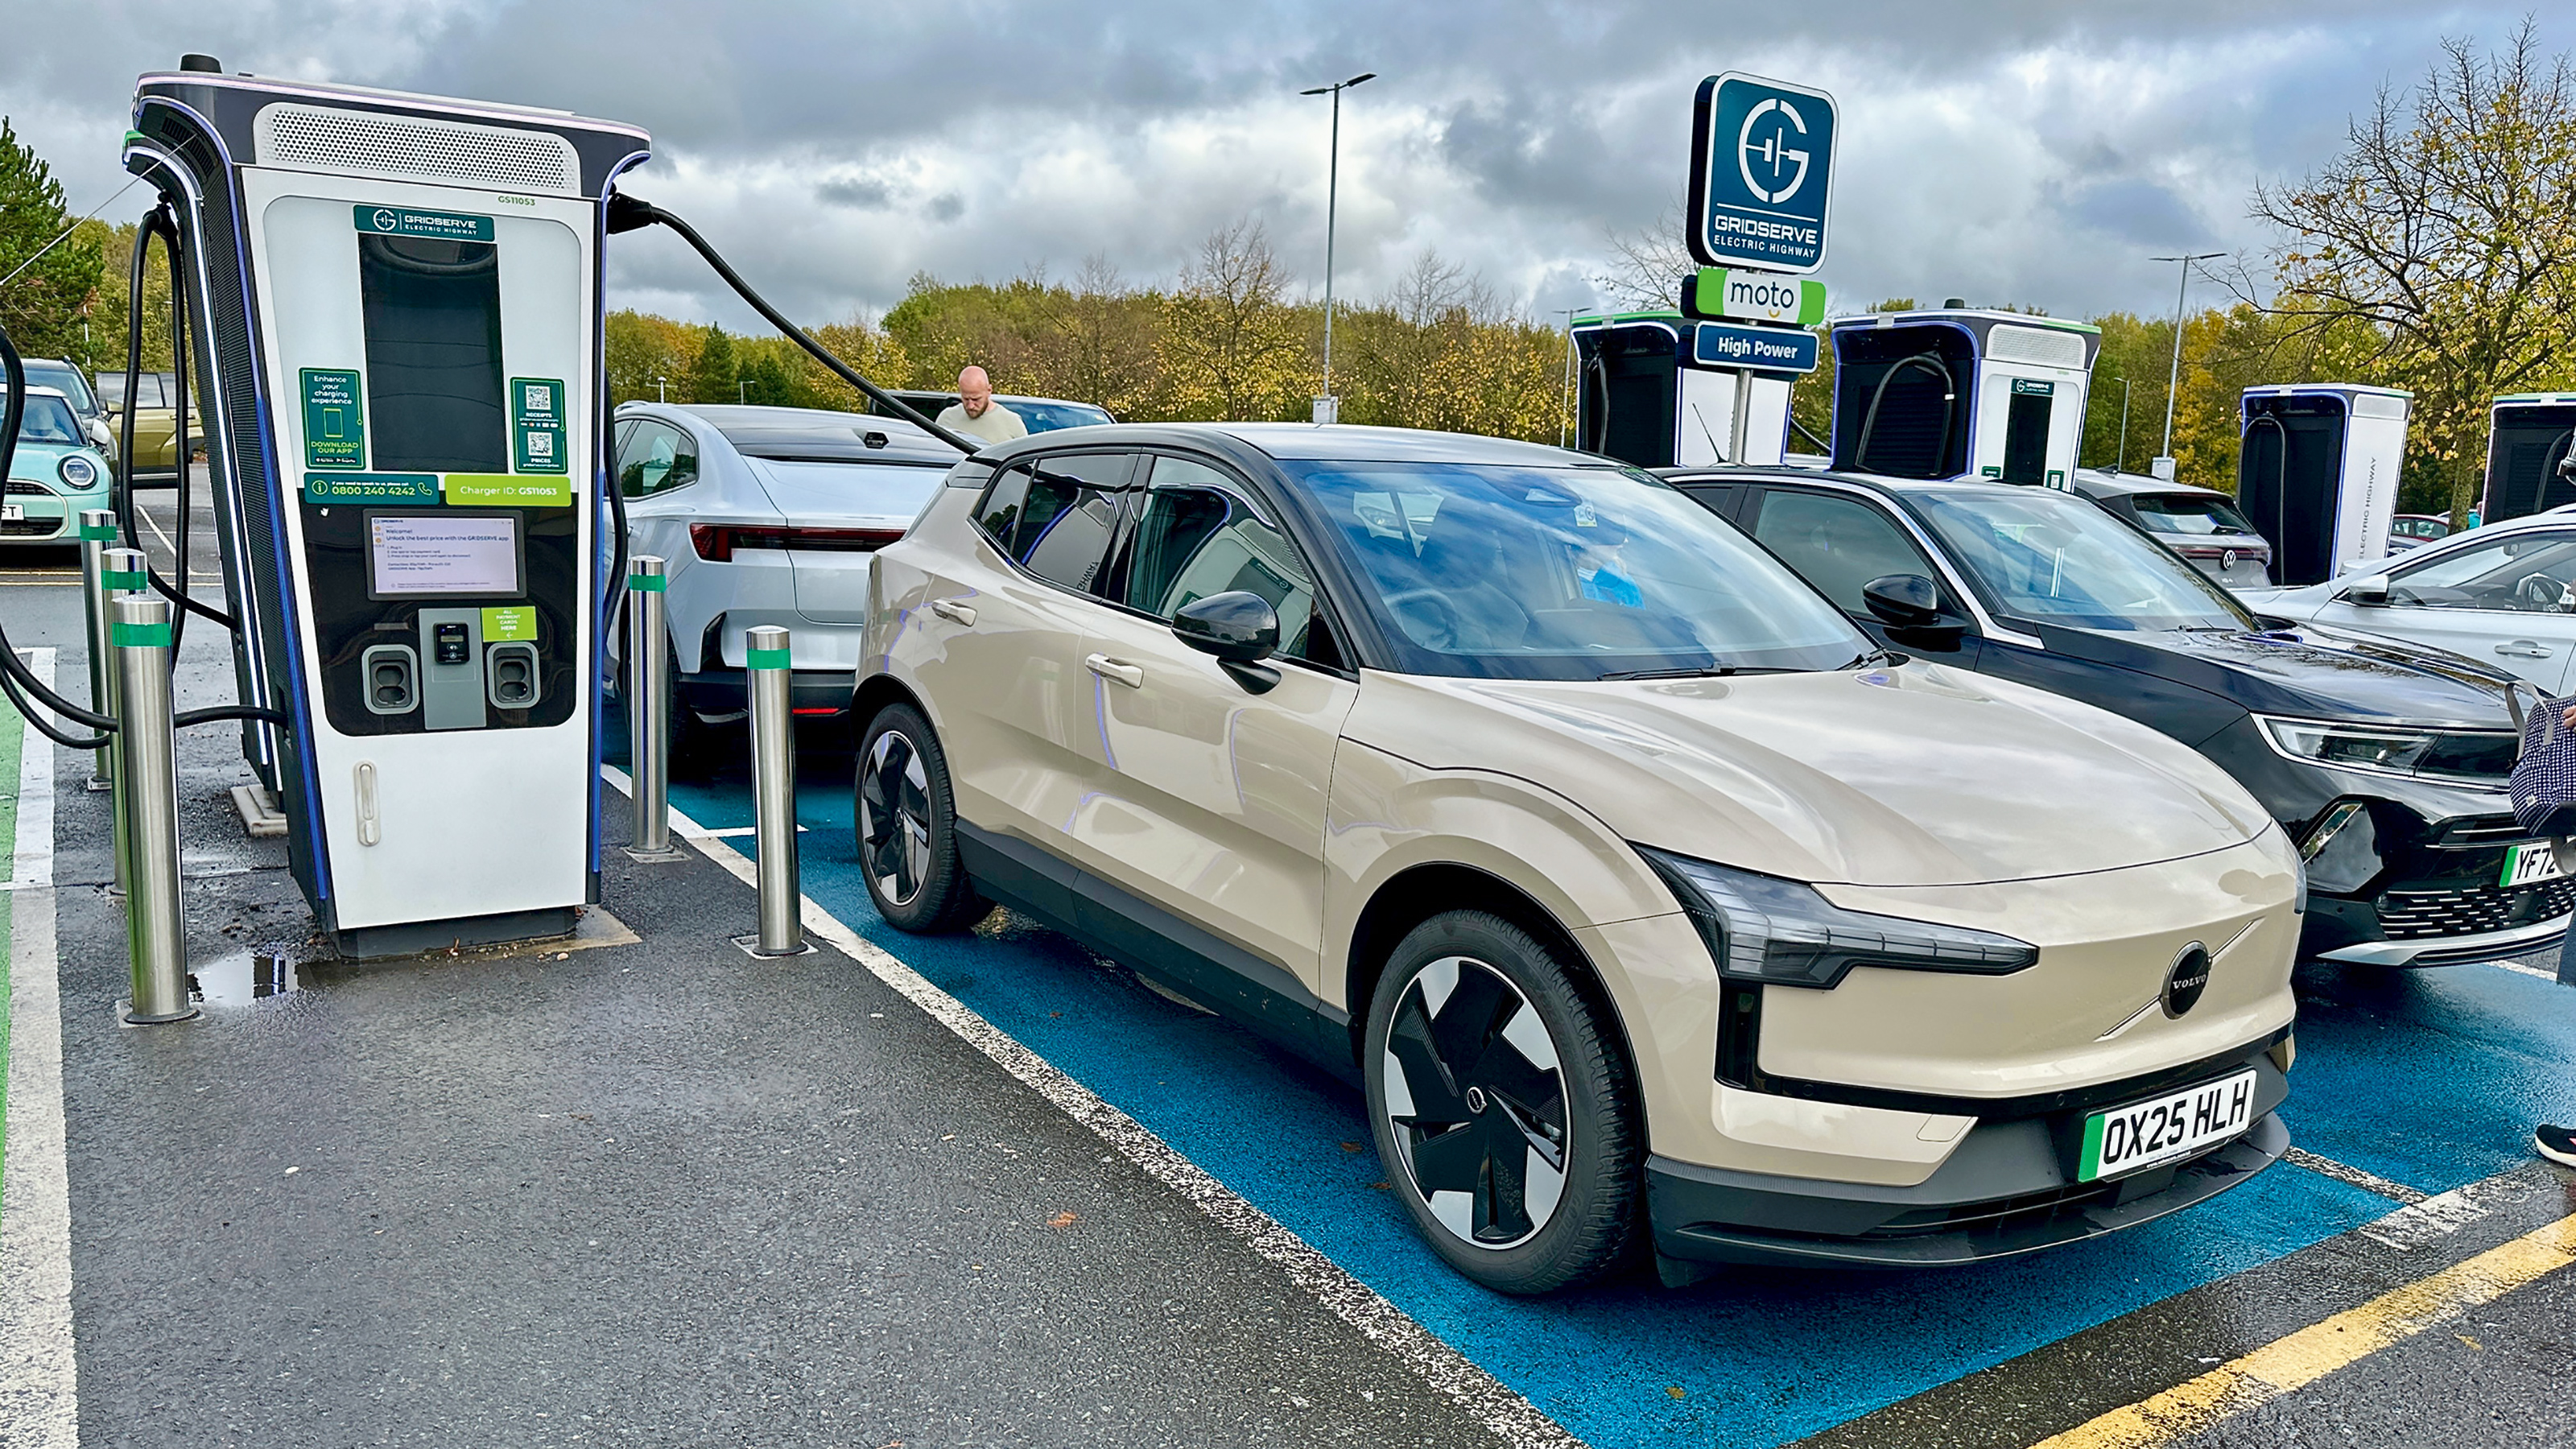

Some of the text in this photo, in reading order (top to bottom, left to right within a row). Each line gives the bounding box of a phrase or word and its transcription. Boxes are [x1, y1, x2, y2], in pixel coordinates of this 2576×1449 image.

[497, 196, 535, 206] GS11053
[404, 215, 477, 229] GRIDSERVE
[405, 224, 477, 235] ELECTRIC HIGHWAY
[1715, 214, 1818, 245] GRIDSERVE
[1714, 234, 1816, 258] ELECTRIC HIGHWAY
[1730, 281, 1794, 308] moto
[1717, 336, 1798, 359] High Power
[314, 375, 347, 383] Enhance
[314, 390, 348, 398] charging
[2365, 456, 2376, 507] HIGHWAY
[332, 486, 415, 496] 0800 240 4242
[460, 486, 557, 497] Charger ID: GS11053
[2173, 974, 2206, 989] VOLVO
[2103, 1080, 2249, 1165] OX25 HLH
